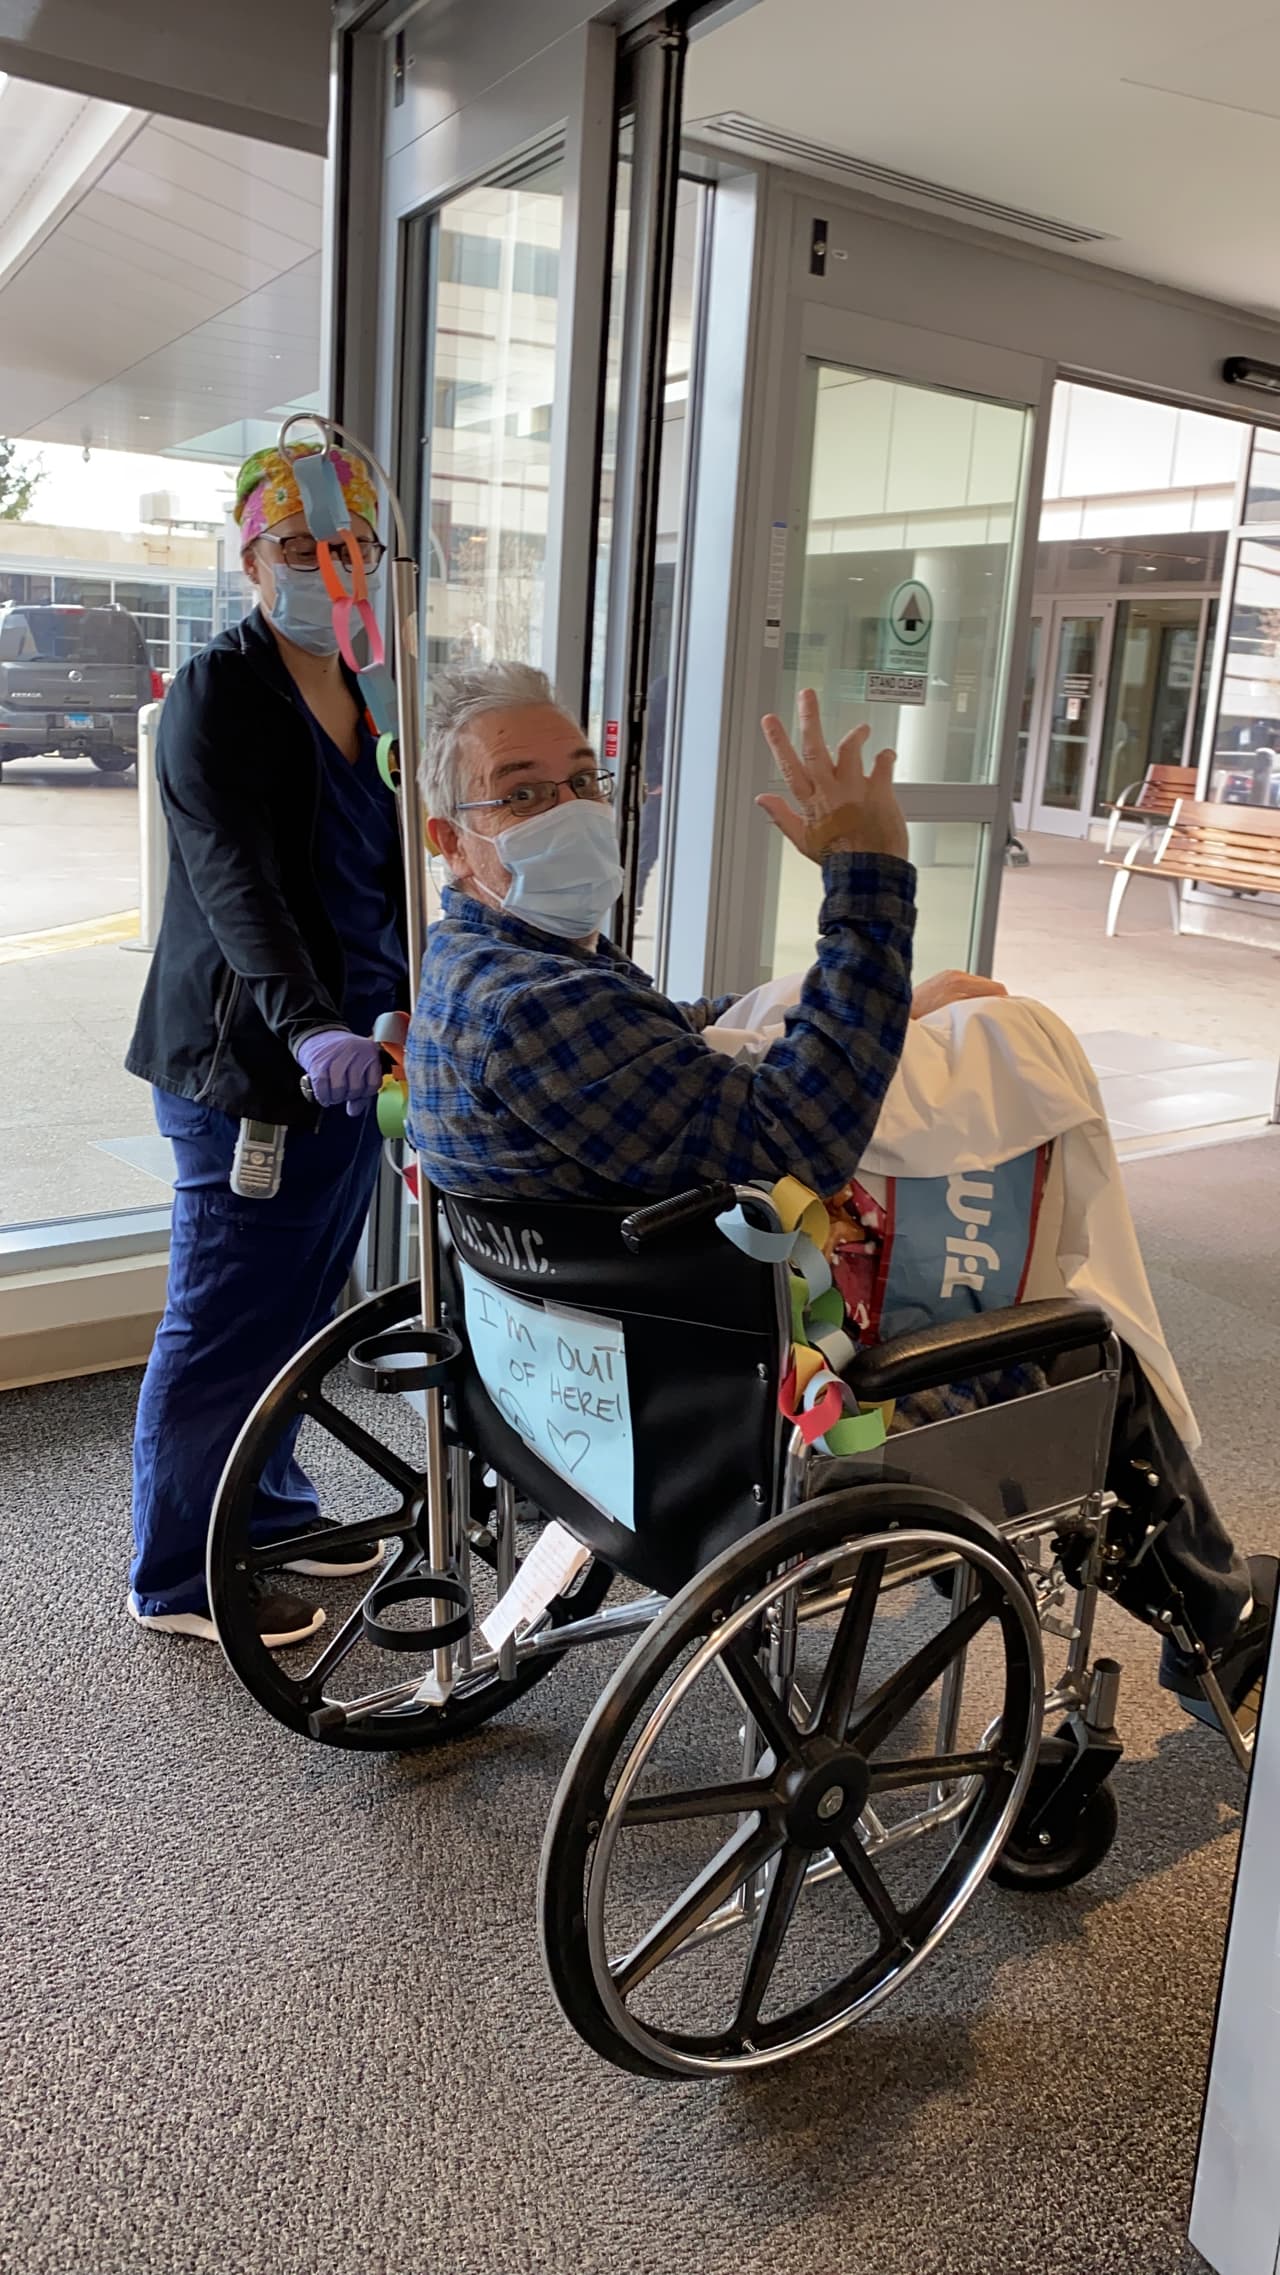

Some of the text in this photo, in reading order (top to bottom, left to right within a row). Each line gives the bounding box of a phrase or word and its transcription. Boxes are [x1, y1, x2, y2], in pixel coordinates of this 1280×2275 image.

[869, 676, 924, 690] STAND CLEAR
[473, 1288, 625, 1384] I'm OUT
[509, 1358, 627, 1438] OF HERE!
